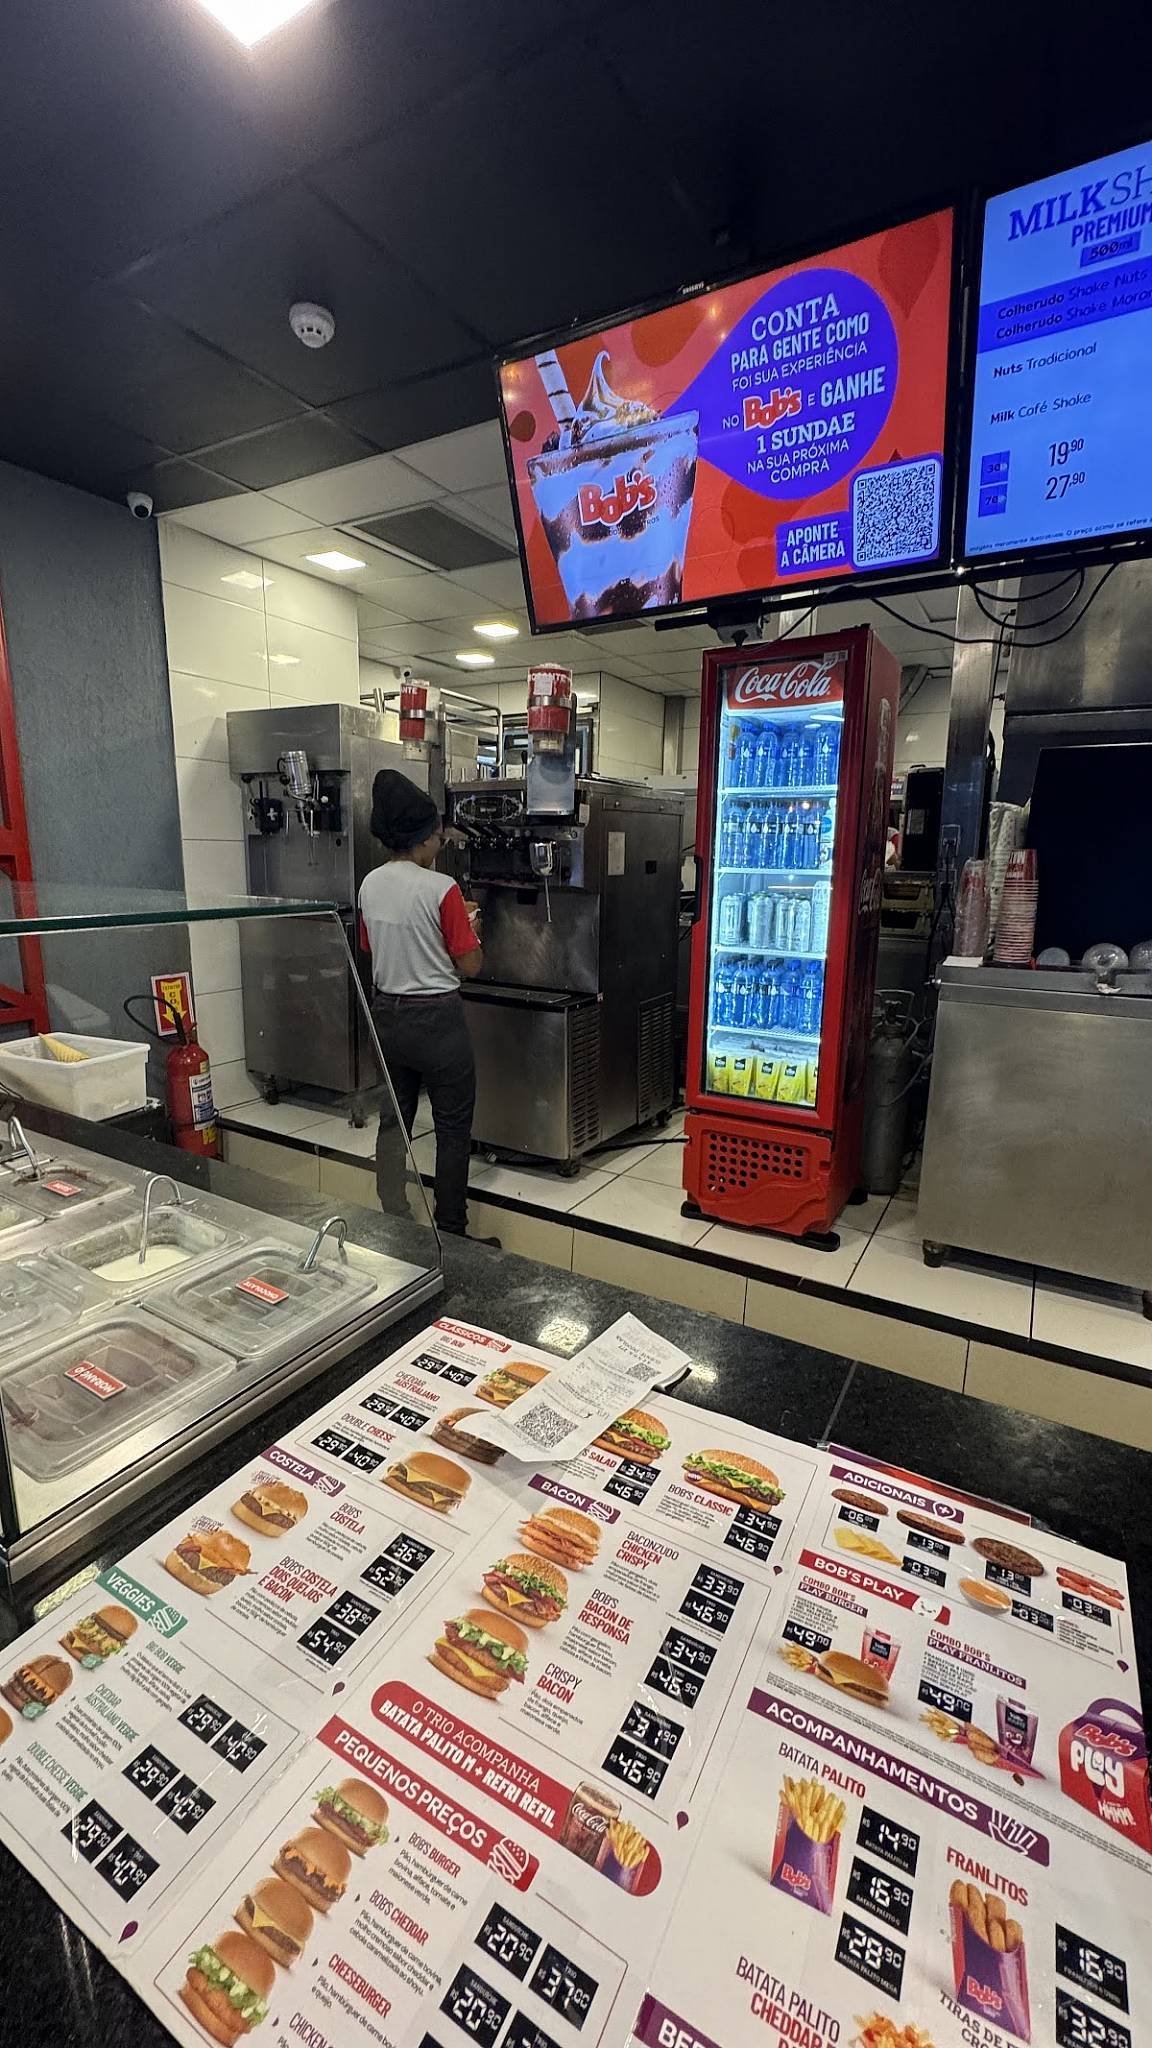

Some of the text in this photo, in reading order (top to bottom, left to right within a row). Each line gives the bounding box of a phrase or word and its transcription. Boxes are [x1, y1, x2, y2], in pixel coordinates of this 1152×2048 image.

[998, 269, 1148, 320] Colherudo Shake Nuts
[751, 292, 840, 342] CONTA
[996, 313, 1063, 339] Colherudo
[1067, 302, 1106, 321] Shake
[731, 312, 870, 374] PARA GENTE COMO
[993, 342, 1097, 379] Nuts Tradicional
[732, 341, 868, 392] FOI SUA EXPERIÊNCIA
[722, 366, 886, 431] NO Bob's E GANHE
[990, 393, 1092, 425] Milk Café Shake
[756, 411, 855, 454] 1 SUNDAE
[747, 438, 849, 475] NA SUA PRÓXIMA
[770, 458, 829, 484] COMPRA
[577, 470, 657, 526] Bob's
[780, 537, 846, 568] A CÂMERA
[786, 521, 839, 548] APONTE
[438, 1321, 487, 1345] CLÁSSICOS
[74, 1366, 115, 1393] MORANGO
[392, 1379, 441, 1403] AUSTRALIANO
[341, 1412, 369, 1432] DOUBLE
[368, 1425, 396, 1444] CHEESE
[269, 1450, 315, 1482] COSTELA
[588, 1452, 618, 1469] SALAD
[541, 1480, 586, 1506] BACON
[668, 1484, 694, 1500] BOB'S
[694, 1494, 734, 1516] CLASSIC
[843, 1471, 927, 1508] ADICIONAIS
[329, 1511, 366, 1535] COSTELA
[338, 1502, 361, 1518] BOB'S
[616, 1549, 650, 1570] CRISPY
[621, 1539, 662, 1565] CHICKEN
[627, 1530, 680, 1561] BACONZUDO
[106, 1571, 156, 1612] VEGGIES
[257, 1576, 295, 1604] E BACON
[268, 1565, 324, 1604] DOIS QUEIJOS
[278, 1555, 339, 1597] BOB'S COSTELA
[803, 1575, 856, 1601] COMBO BOB'S
[814, 1557, 905, 1601] BOB'S PLAY
[584, 1599, 634, 1631] BACON DE
[591, 1588, 619, 1609] BOB'S
[800, 1583, 825, 1599] PLAY
[825, 1592, 864, 1615] BURGER
[578, 1610, 630, 1645] RESPONSA
[930, 1629, 991, 1662] COMBO BOB'S
[545, 1662, 582, 1690] CRISPY
[928, 1638, 957, 1655] PLAY
[958, 1650, 1023, 1686] FRANLITOS
[537, 1675, 574, 1704] BACON
[412, 1700, 541, 1793] O TRIO ACOMPANHA
[1074, 1723, 1138, 1757] Bob's
[378, 1699, 422, 1740] BATATA
[421, 1723, 463, 1764] PALITO
[461, 1753, 476, 1772] M
[482, 1768, 522, 1802] REFRI
[518, 1793, 556, 1829] REFIL
[765, 1702, 979, 1822] ACOMPANHAMENTOS
[777, 1742, 867, 1798] BATATA PALITO
[334, 1730, 488, 1848] PEQUENOS PREÇOS
[408, 1832, 461, 1879] BOB'S BURGER
[946, 1847, 1029, 1907] FRANLITOS
[369, 1889, 429, 1946] BOB'S CHEDDAR
[328, 1953, 392, 2019] CHEESEBURGER
[736, 1955, 840, 2044] BATATA PALITO
[750, 1992, 823, 2048] CHEDDAR
[940, 1991, 980, 2033] TIRAS
[983, 2027, 1003, 2048] DE
